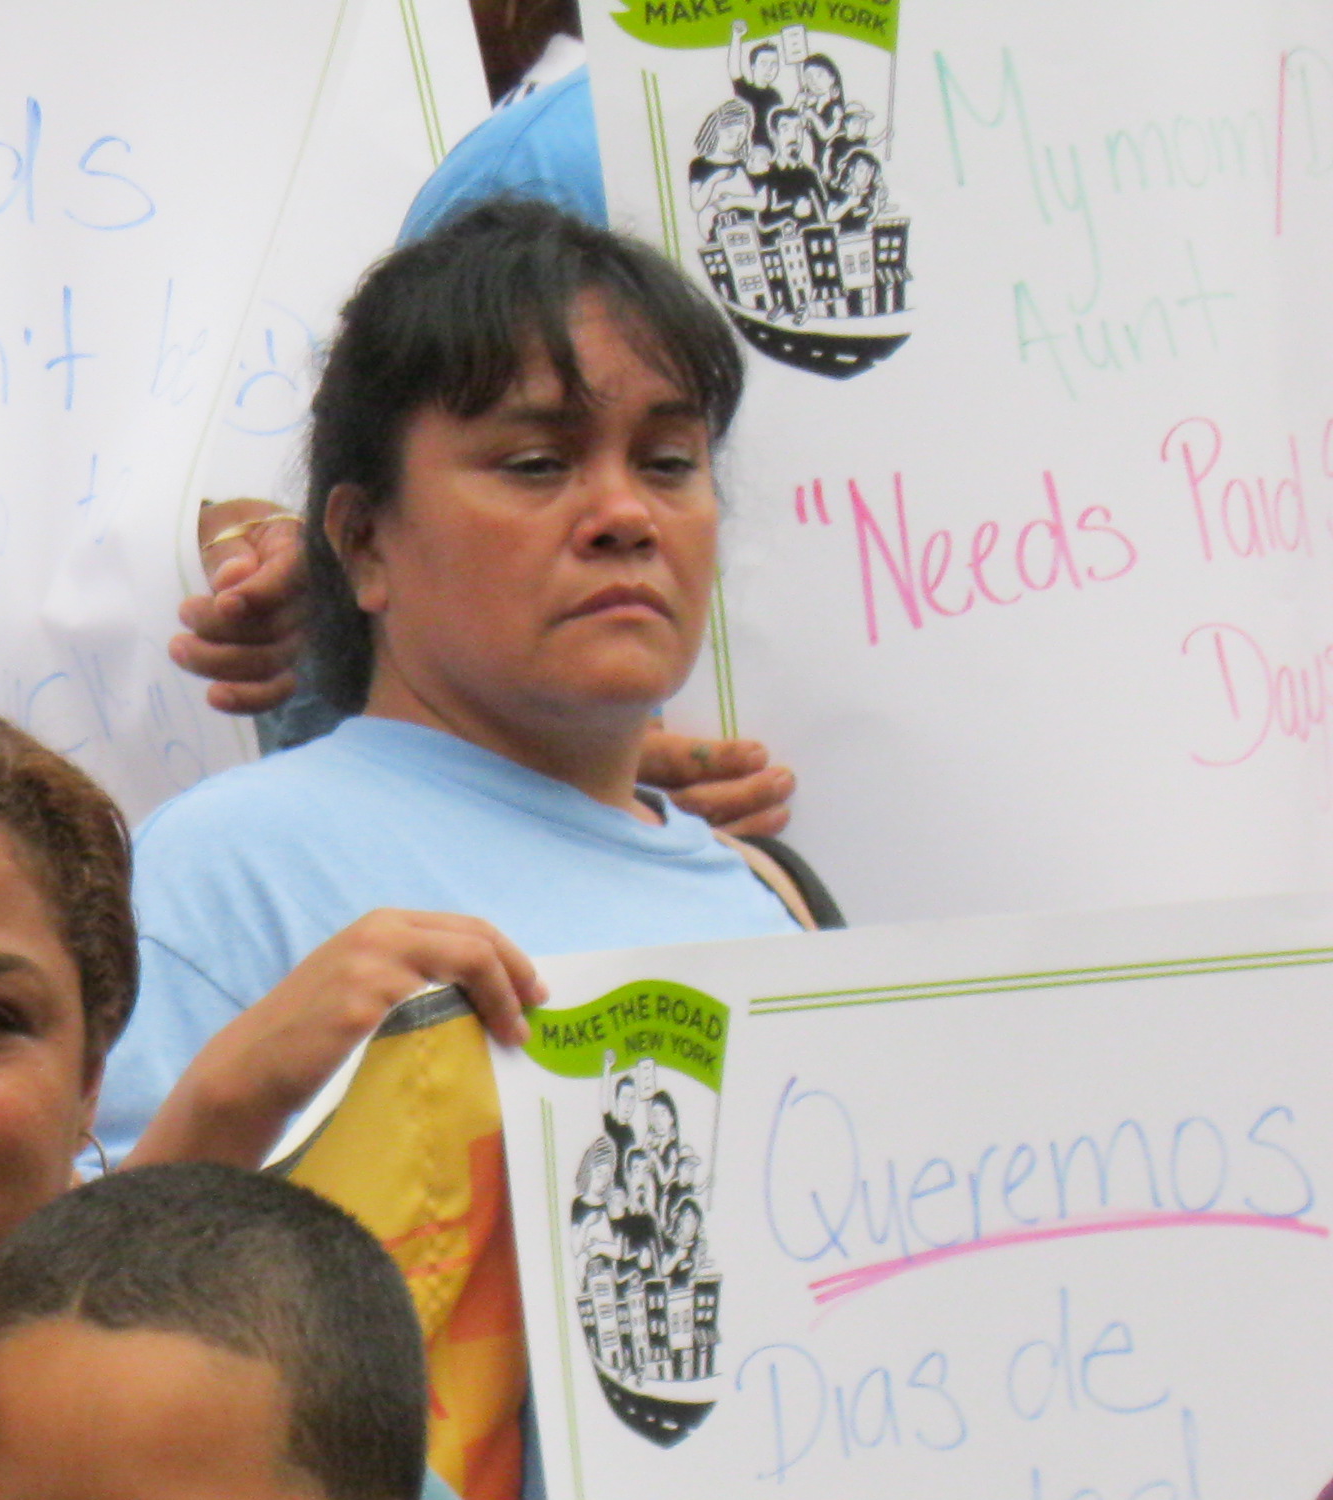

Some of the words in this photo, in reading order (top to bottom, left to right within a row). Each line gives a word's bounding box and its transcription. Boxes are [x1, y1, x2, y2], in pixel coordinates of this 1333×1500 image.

[759, 1, 818, 26] NEW
[828, 2, 889, 34] YORK
[932, 46, 1103, 315] My
[1013, 240, 1235, 402] Aunt
[1160, 416, 1313, 562] Paid
[540, 1013, 606, 1050] MAKE
[607, 993, 650, 1032] THE
[656, 994, 723, 1042] ROAD
[624, 1030, 665, 1056] NEW
[669, 1032, 718, 1070] YORK
[763, 1075, 1316, 1264] Queremos
[1006, 1286, 1169, 1423] de
